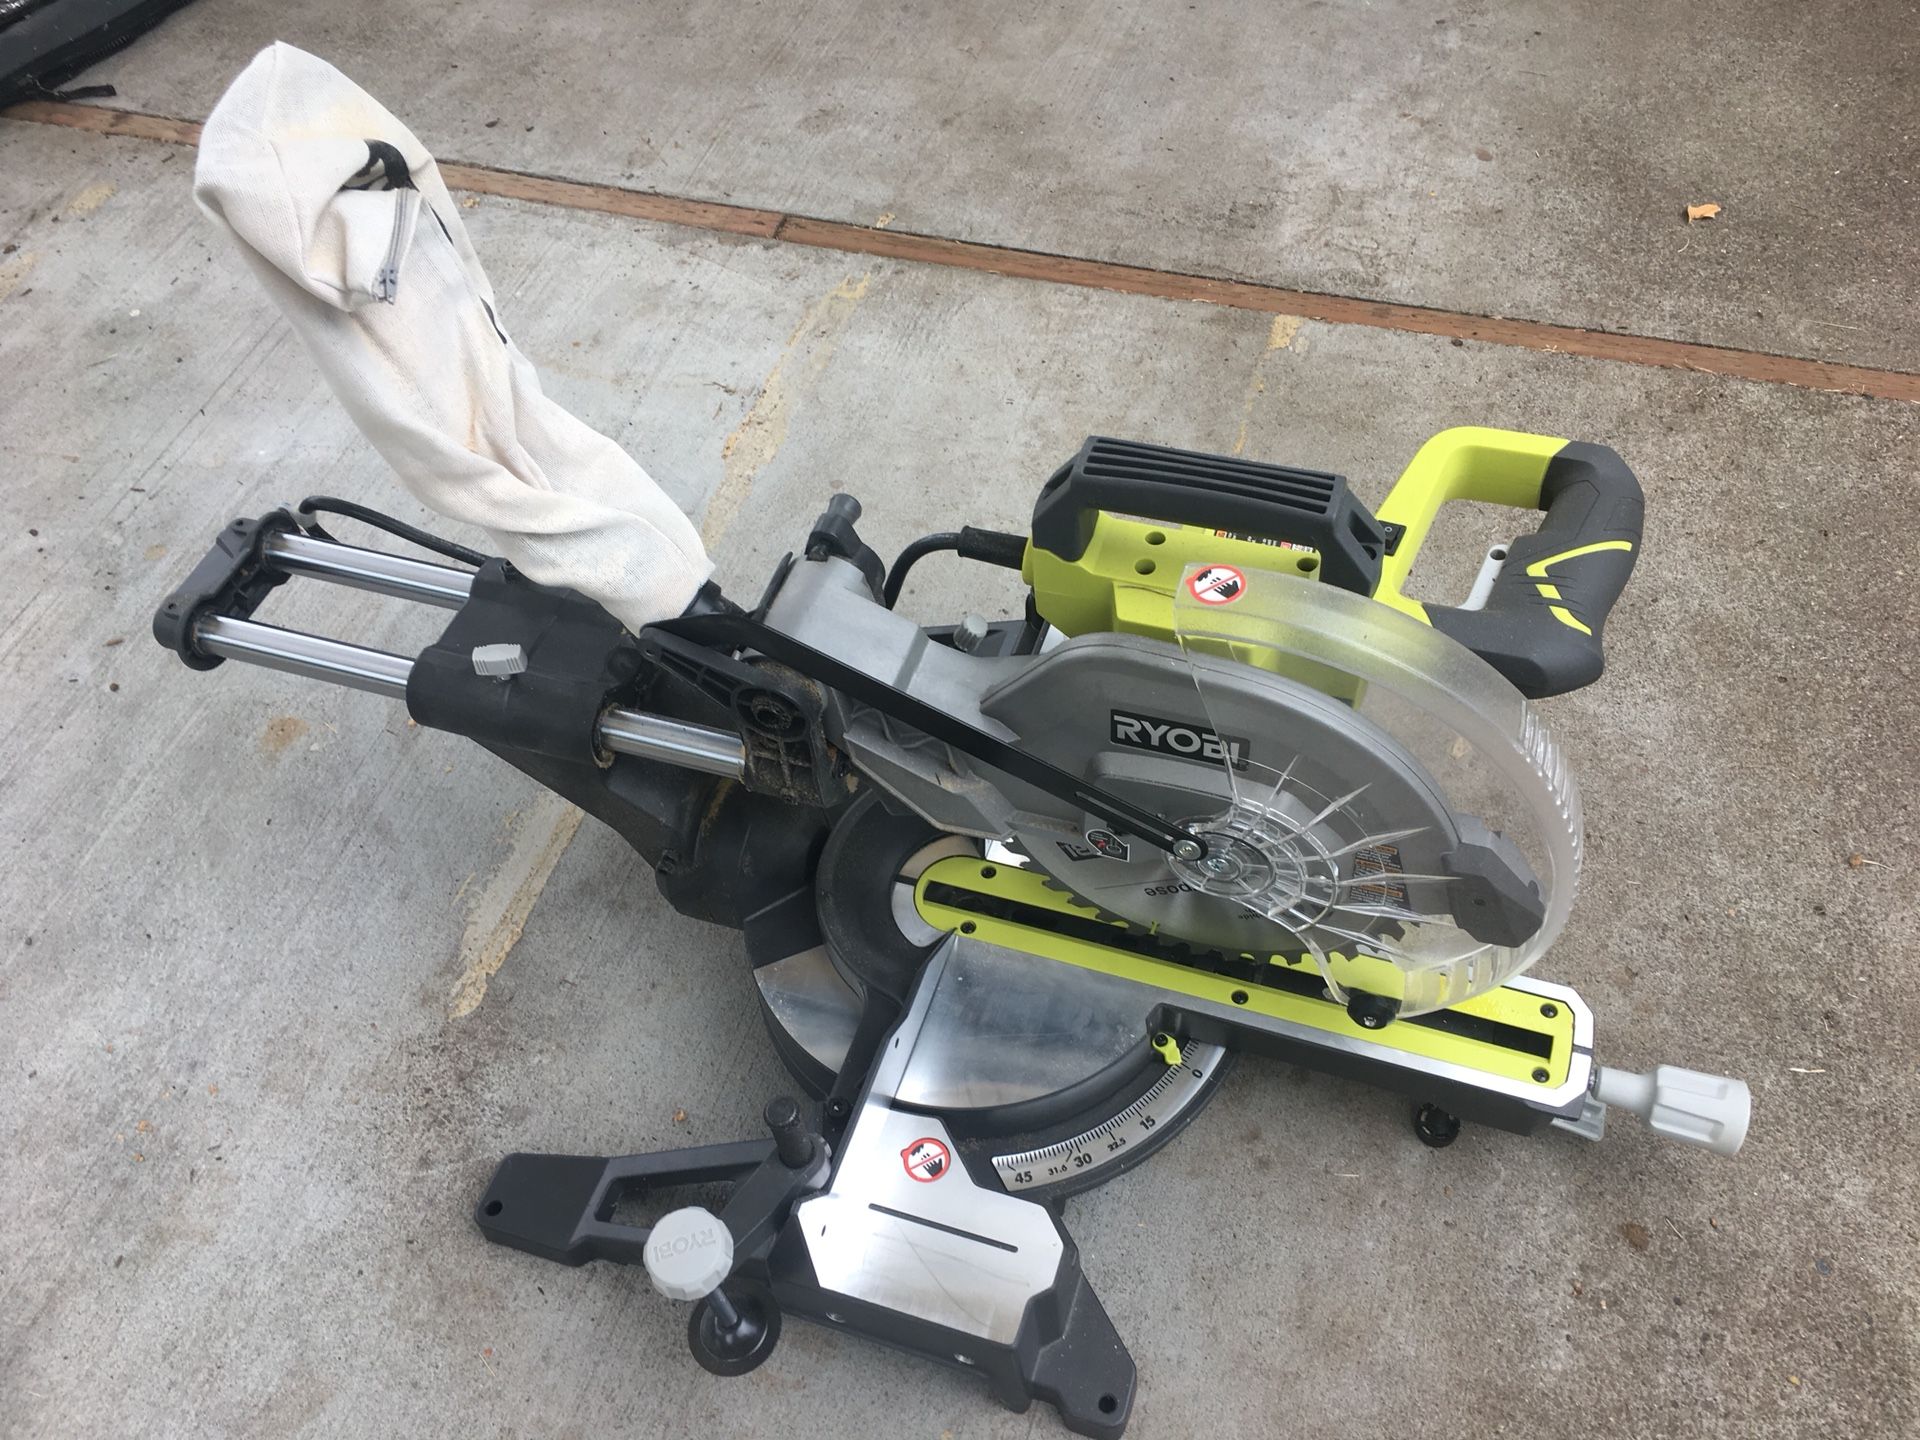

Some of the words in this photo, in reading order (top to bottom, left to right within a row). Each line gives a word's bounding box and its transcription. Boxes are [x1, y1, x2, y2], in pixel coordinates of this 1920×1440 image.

[1113, 715, 1240, 764] RYOBI
[1144, 881, 1194, 897] pose
[1014, 1170, 1033, 1184] 45
[1047, 1164, 1068, 1176] 31.6
[1073, 1152, 1093, 1168] 30
[1107, 1138, 1126, 1152] 22.5
[1139, 1115, 1156, 1131] 15
[1191, 1068, 1203, 1079] 0
[653, 1228, 717, 1263] RYOBI
